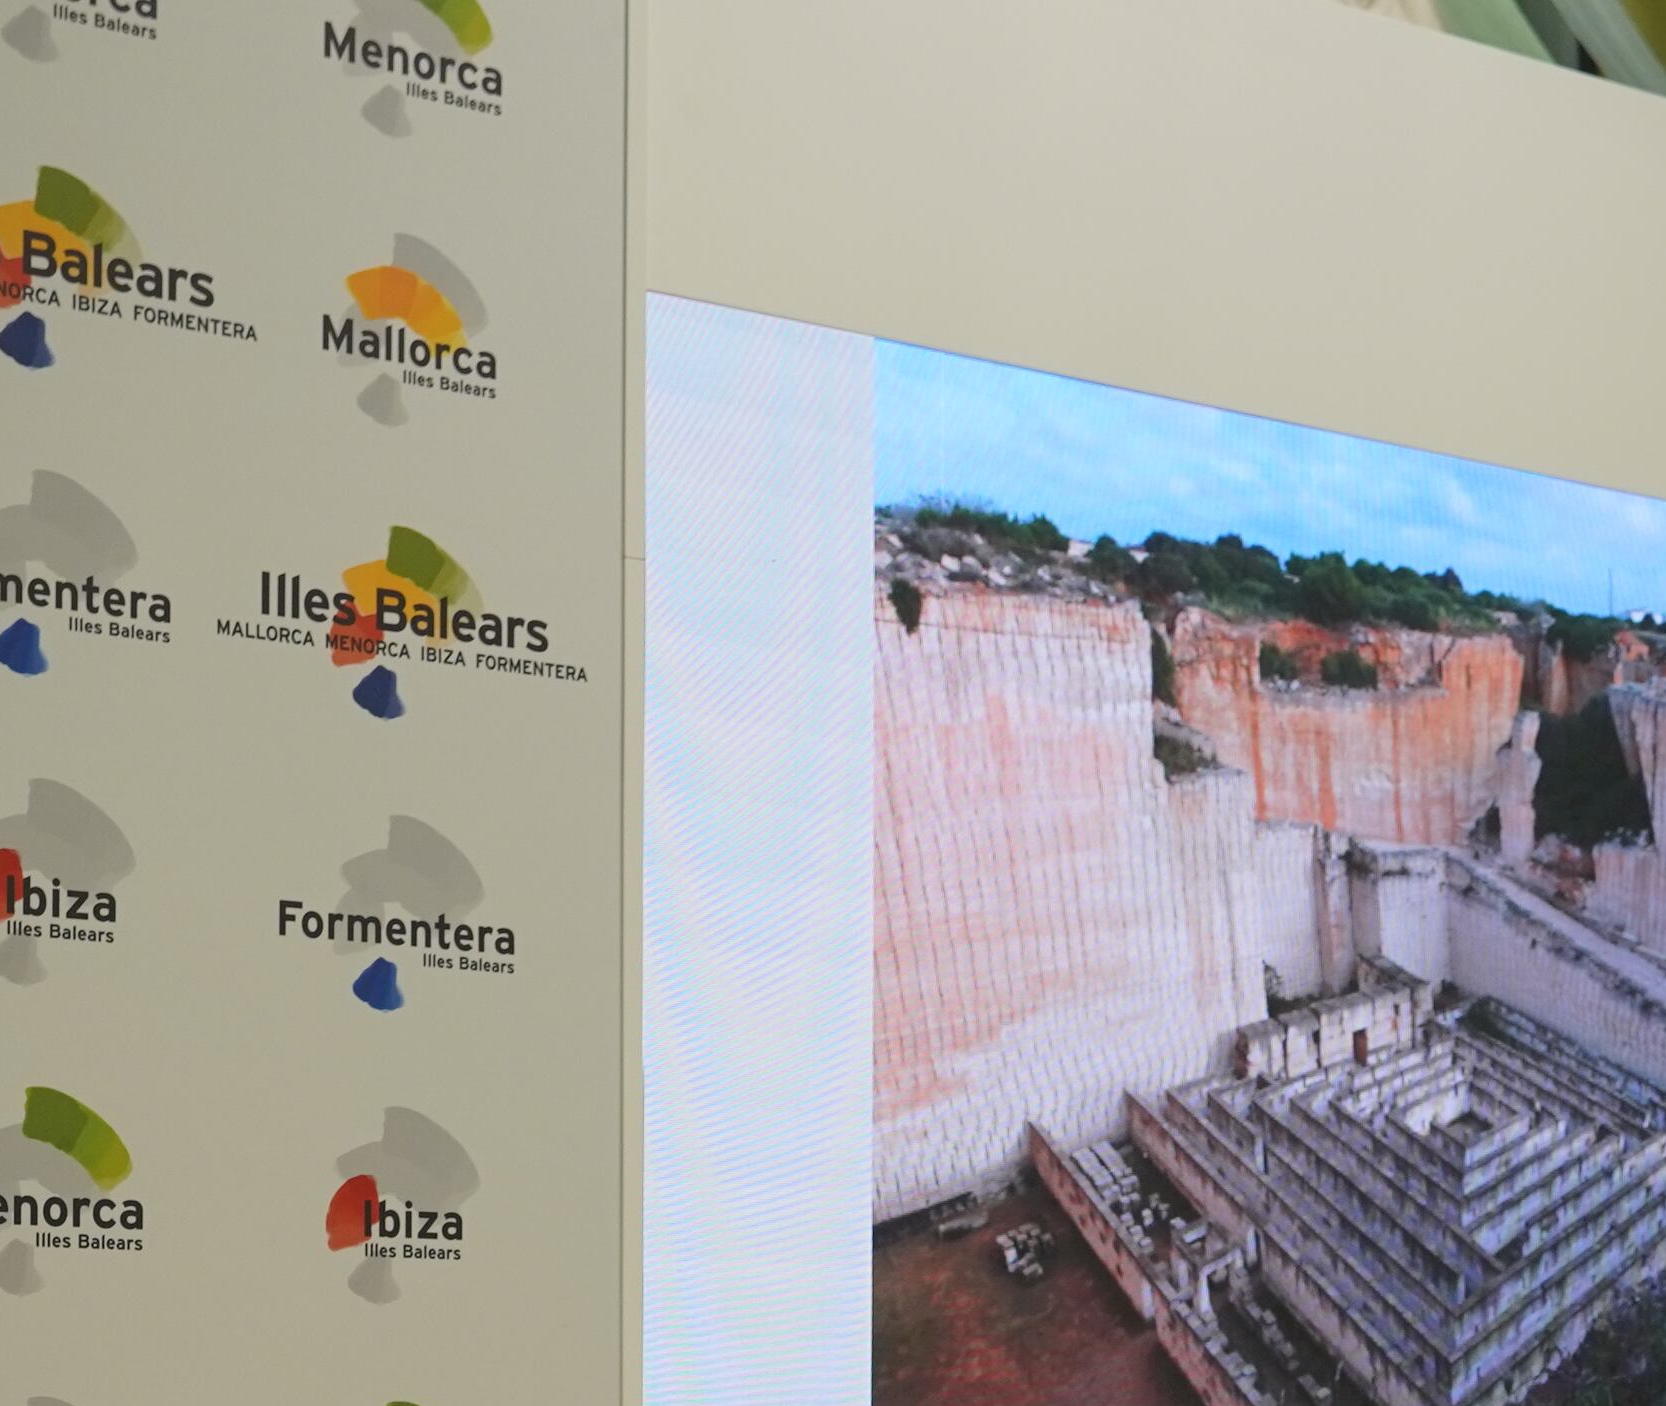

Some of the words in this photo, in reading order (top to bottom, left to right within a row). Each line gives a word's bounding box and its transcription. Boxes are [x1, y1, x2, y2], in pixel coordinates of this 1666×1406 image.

[53, 4, 88, 25] Illes
[94, 13, 157, 40] Balears
[324, 21, 502, 97] Menorca
[406, 81, 438, 102] Illes
[444, 90, 502, 116] Balears
[21, 229, 215, 308] Balears
[72, 293, 122, 318] IBIZA
[133, 304, 257, 342] FORMENTERA
[322, 313, 497, 380] Mallorca
[403, 370, 434, 388] Illes
[439, 376, 496, 399] Balears
[69, 616, 103, 635] Illes
[109, 621, 171, 644] Balears
[261, 570, 357, 627] Illes
[375, 587, 549, 653] Balears
[217, 618, 315, 647] MALLORCA
[324, 633, 411, 661] MENORCA
[421, 646, 466, 667] IBIZA
[476, 653, 588, 682] FORMENTERA
[5, 875, 117, 923] Ibiza
[6, 920, 43, 938] Illes
[49, 923, 115, 944] Balears
[278, 899, 515, 956] Formentera
[423, 953, 454, 969] Illes
[459, 956, 515, 974] Balears
[362, 1199, 463, 1241] Ibiza
[35, 1231, 72, 1249] Illes
[78, 1233, 143, 1252] Balears
[364, 1242, 397, 1259] Illes
[402, 1243, 461, 1261] Balears
